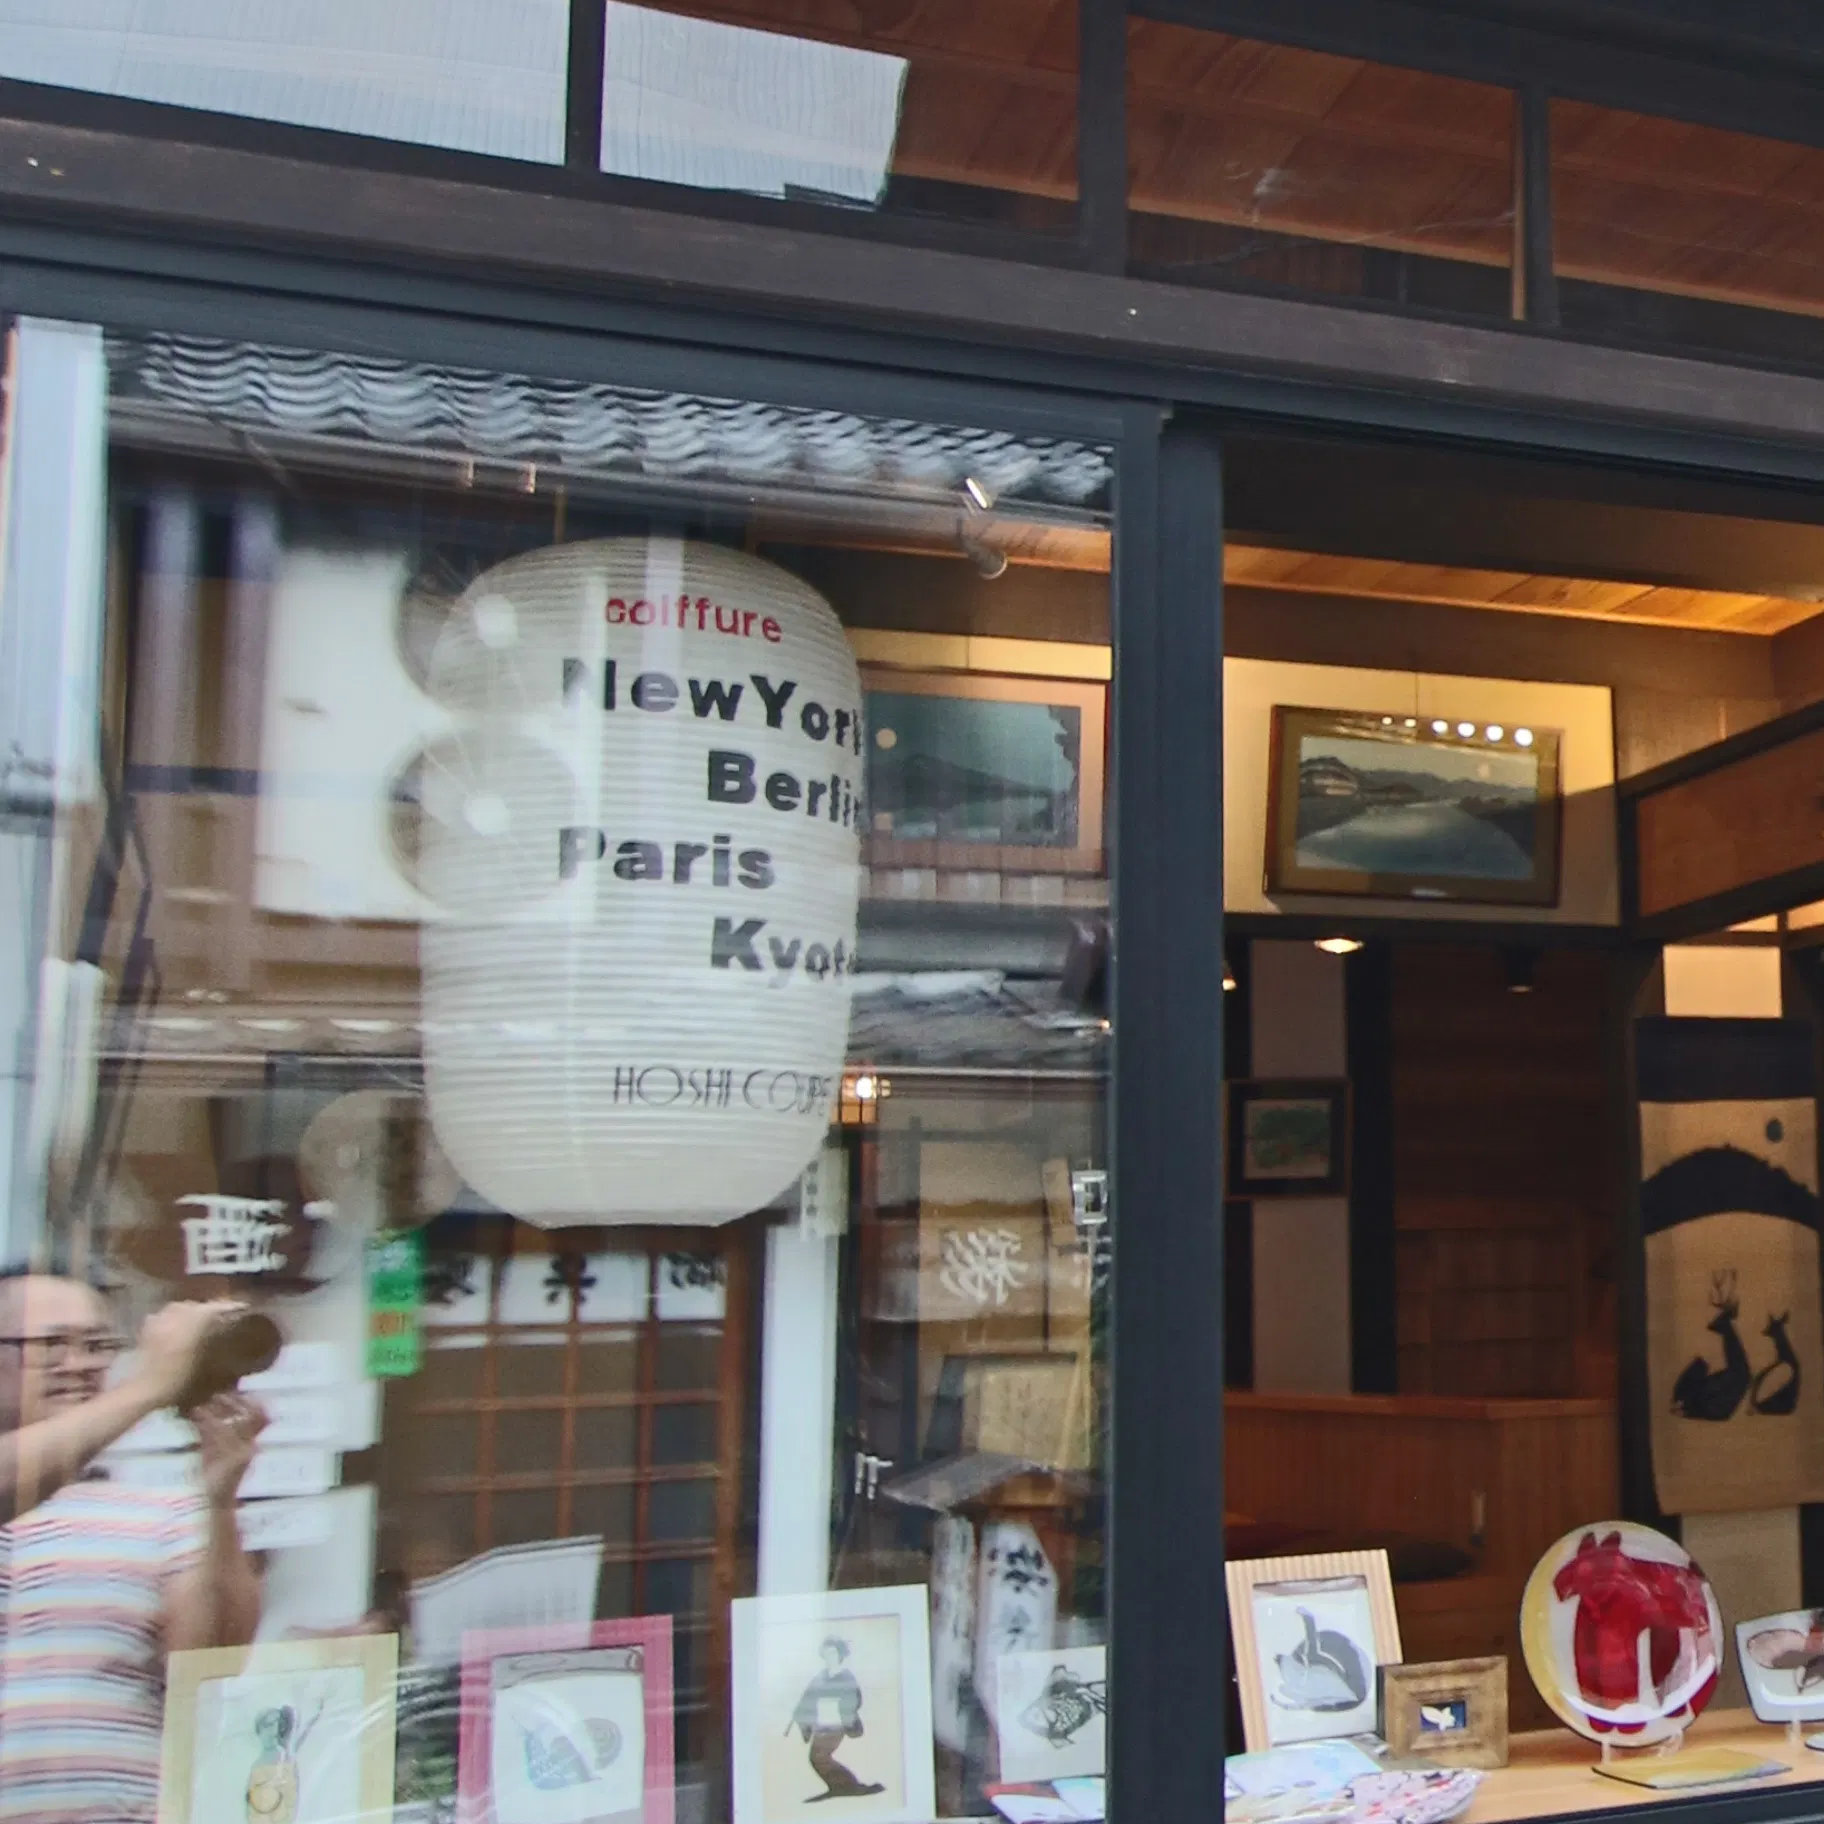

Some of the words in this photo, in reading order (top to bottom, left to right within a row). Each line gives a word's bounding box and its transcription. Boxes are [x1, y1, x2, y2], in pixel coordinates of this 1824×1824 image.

[605, 593, 783, 643] coiffure
[558, 827, 775, 889] Paris
[710, 916, 856, 989] Kyot
[612, 1065, 732, 1108] HOSHI
